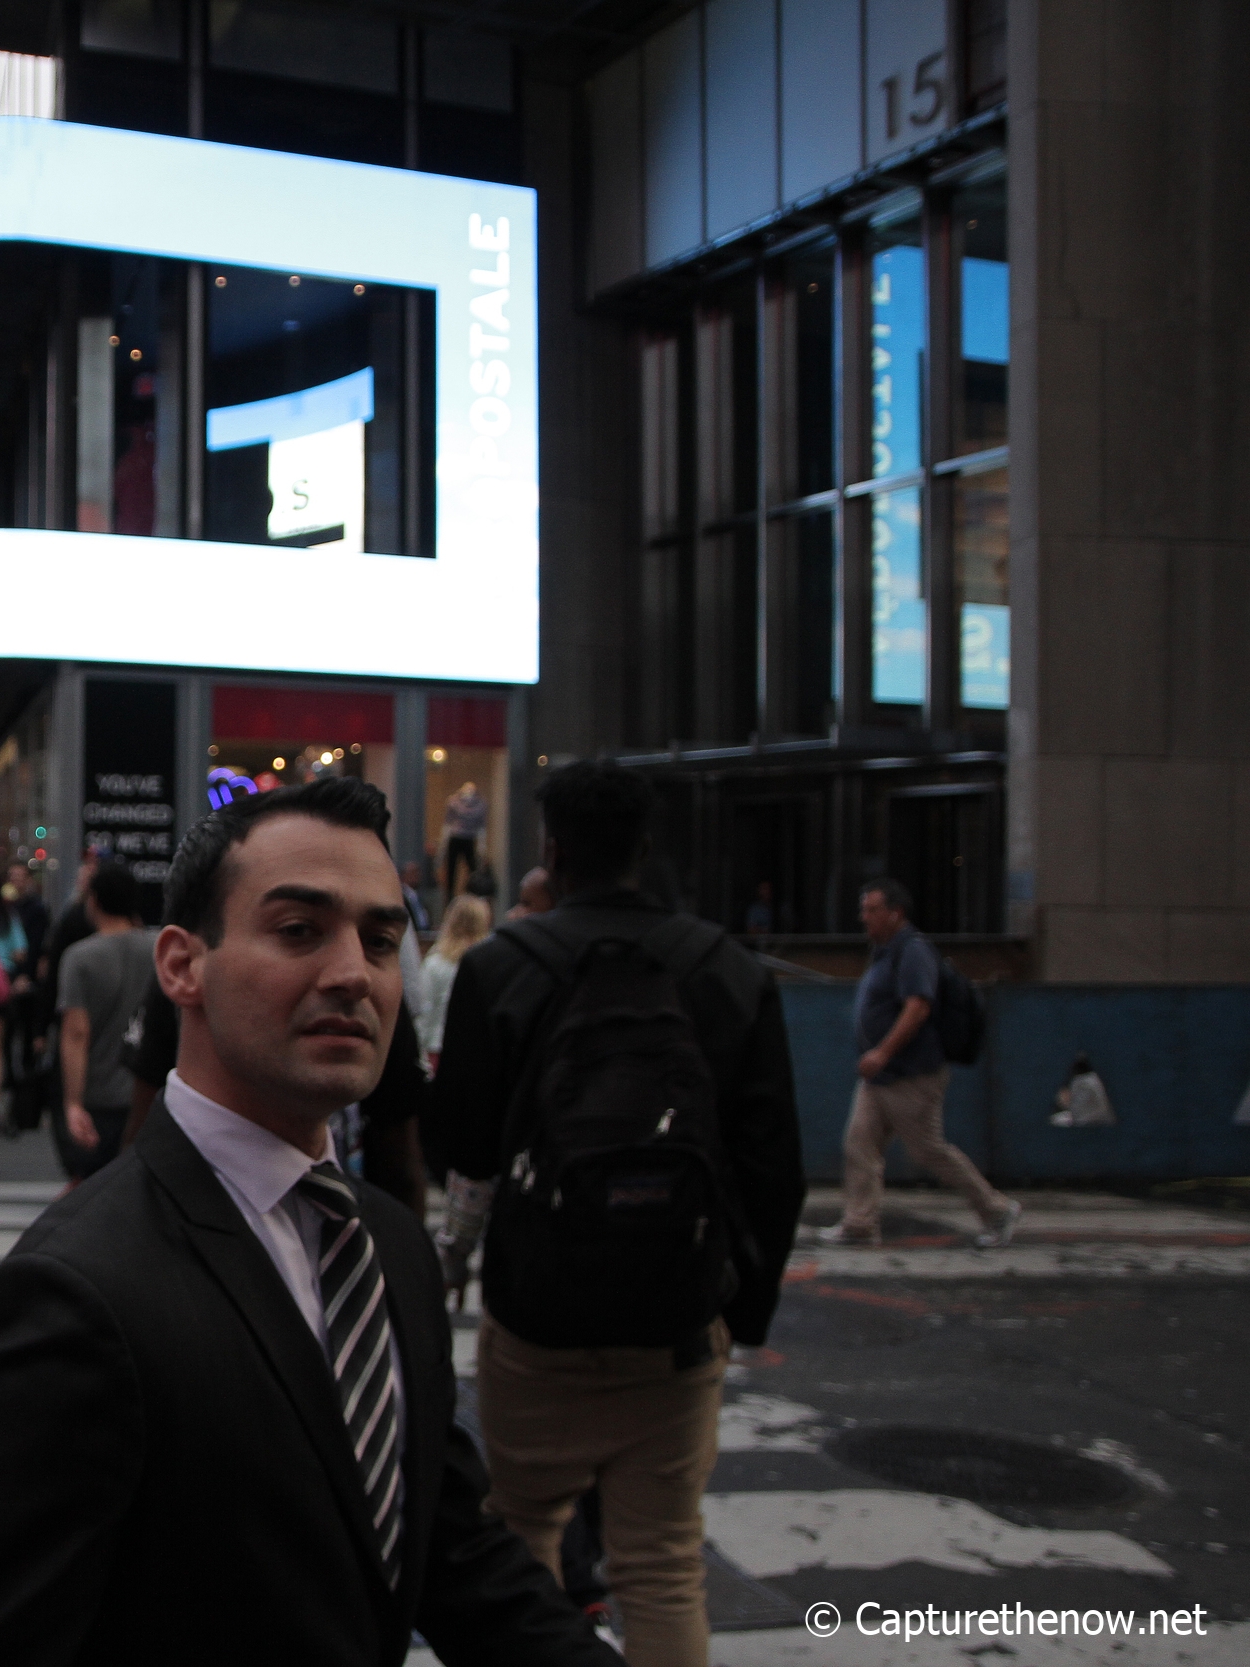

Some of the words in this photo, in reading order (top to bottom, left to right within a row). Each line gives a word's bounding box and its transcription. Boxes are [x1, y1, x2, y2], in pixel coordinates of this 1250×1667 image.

[880, 53, 945, 139] 15
[95, 773, 164, 797] YOU'VE
[83, 802, 174, 826] CHANGED
